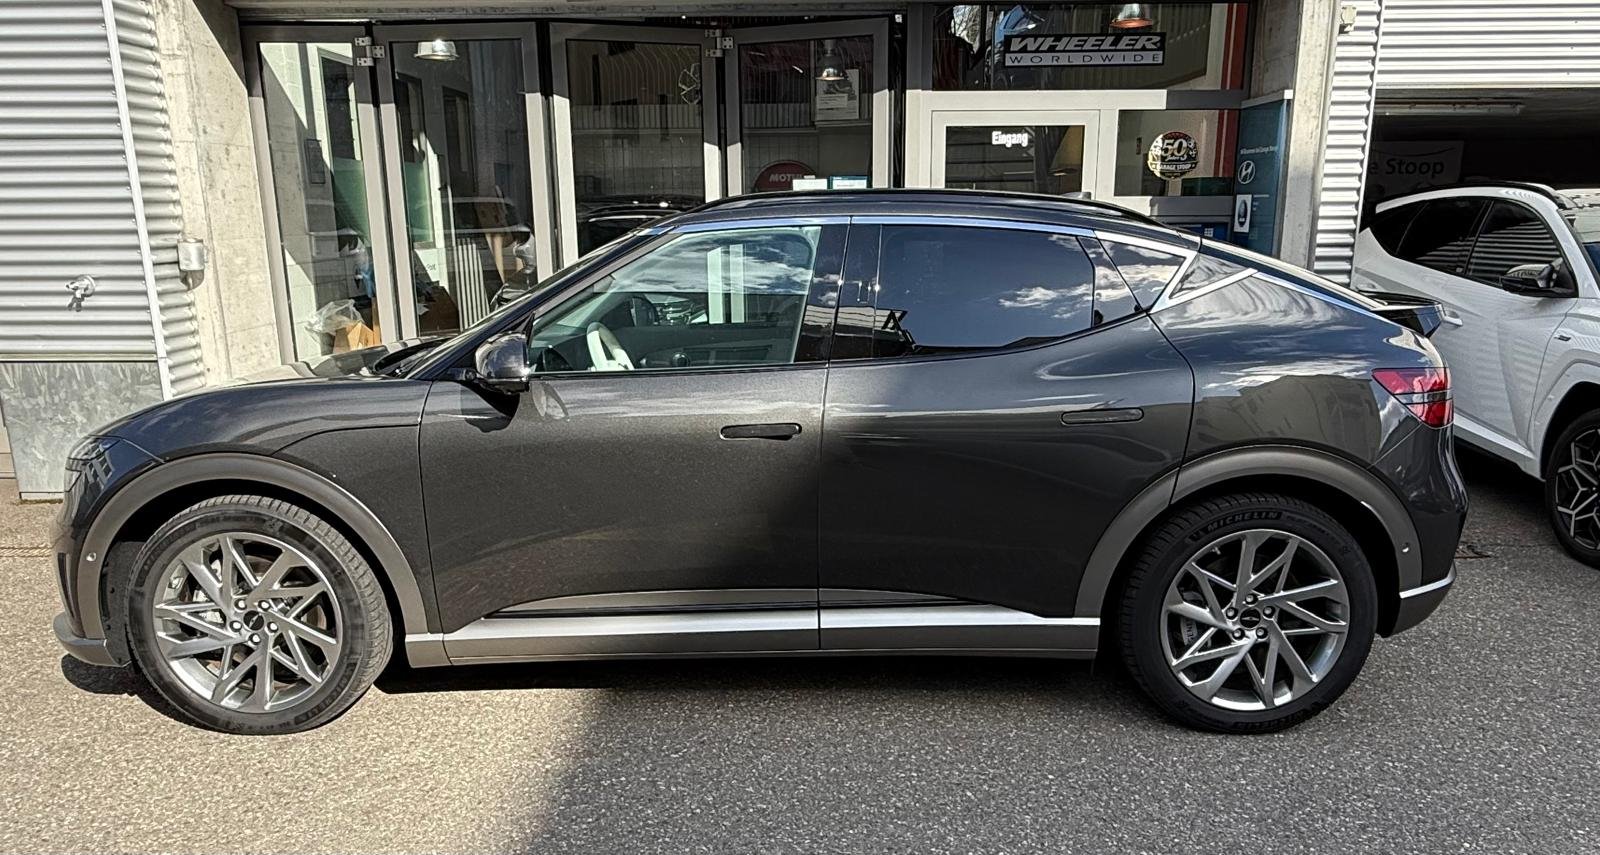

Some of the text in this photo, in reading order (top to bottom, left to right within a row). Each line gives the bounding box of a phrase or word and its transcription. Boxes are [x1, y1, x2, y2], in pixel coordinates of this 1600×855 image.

[1010, 36, 1160, 51] WHEELER
[1009, 53, 1160, 64] WORLDWIDE
[992, 131, 1028, 147] Eingang
[1161, 139, 1187, 156] 50
[1386, 158, 1444, 179] Stoop
[1207, 511, 1277, 532] MICHELIN
